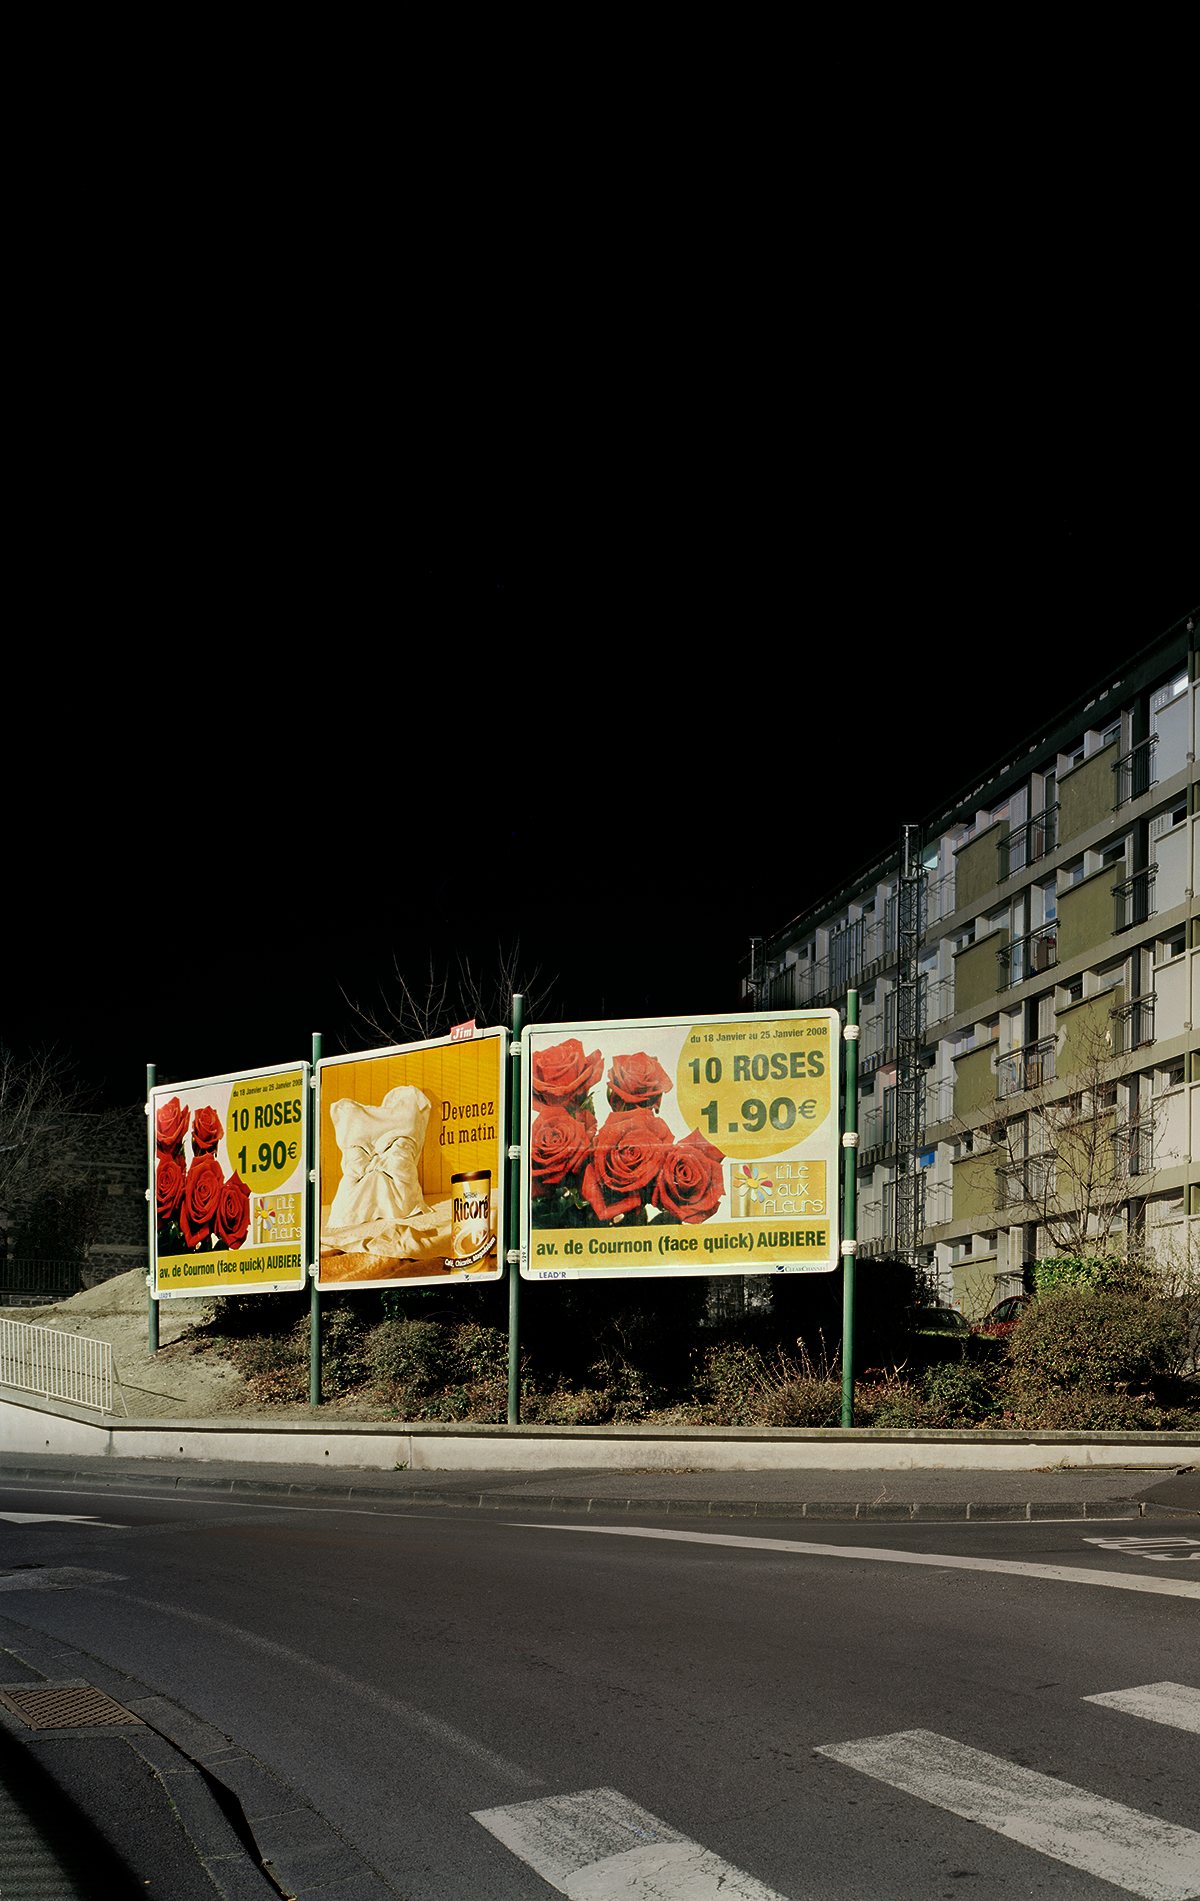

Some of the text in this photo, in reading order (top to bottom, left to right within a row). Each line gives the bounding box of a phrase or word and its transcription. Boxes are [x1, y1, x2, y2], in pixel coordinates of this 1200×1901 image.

[453, 1027, 472, 1040] Jim
[690, 1026, 828, 1043] du 18 Janvier au 25 Janvier 2008
[688, 1050, 825, 1084] 10 ROSES
[246, 1086, 262, 1096] Janvier
[275, 1081, 292, 1090] Janvier
[232, 1098, 302, 1132] 10 ROSES
[442, 1101, 495, 1121] Devenez
[701, 1097, 817, 1134] 1.90€
[439, 1126, 455, 1146] du
[238, 1140, 298, 1174] 1.90€
[453, 1195, 489, 1223] Ricoré
[536, 1230, 826, 1256] av. de Cournon (face quick) AUBIERE
[159, 1253, 302, 1279] av. de Cournon (face quick) AUBIERE
[538, 1271, 567, 1279] LEAD'R
